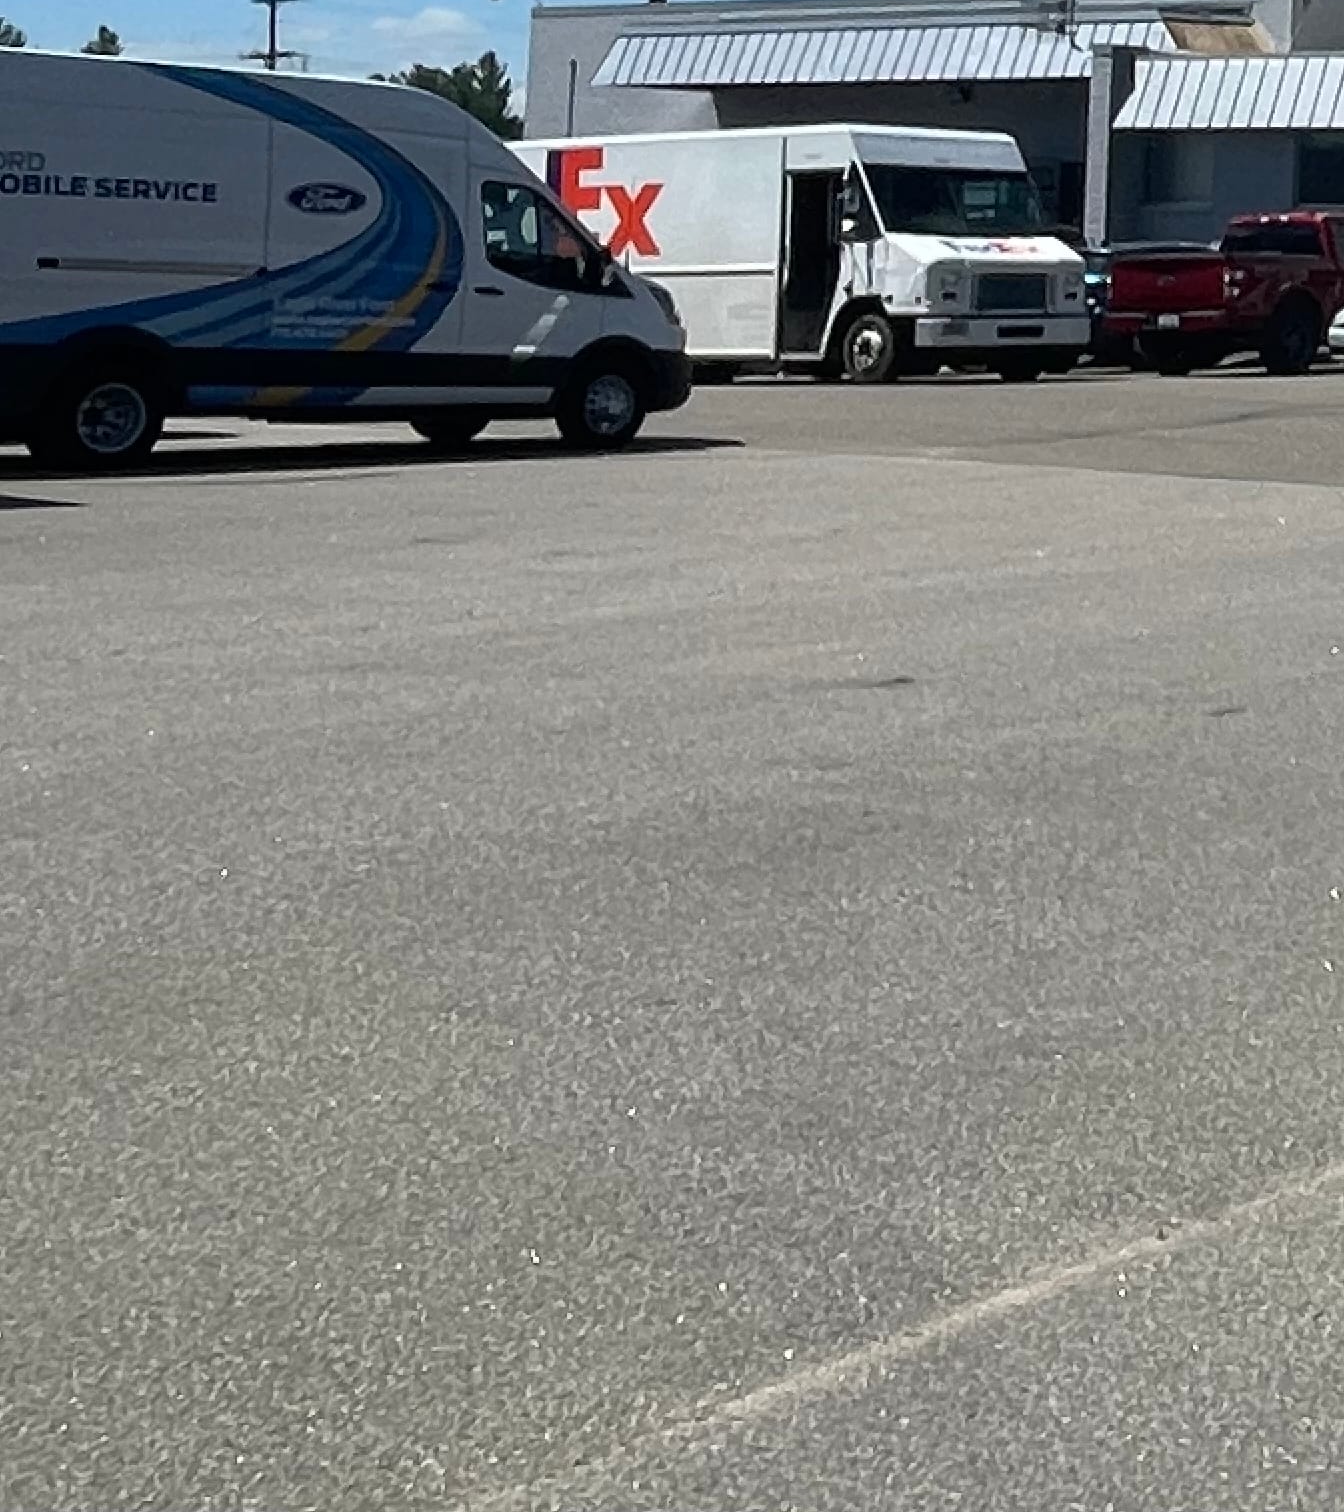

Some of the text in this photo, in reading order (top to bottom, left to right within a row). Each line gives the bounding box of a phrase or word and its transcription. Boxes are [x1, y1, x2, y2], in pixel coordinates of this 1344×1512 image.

[0, 150, 46, 172] RD
[0, 173, 218, 203] OBILE SERVICE
[548, 146, 664, 257] Ex
